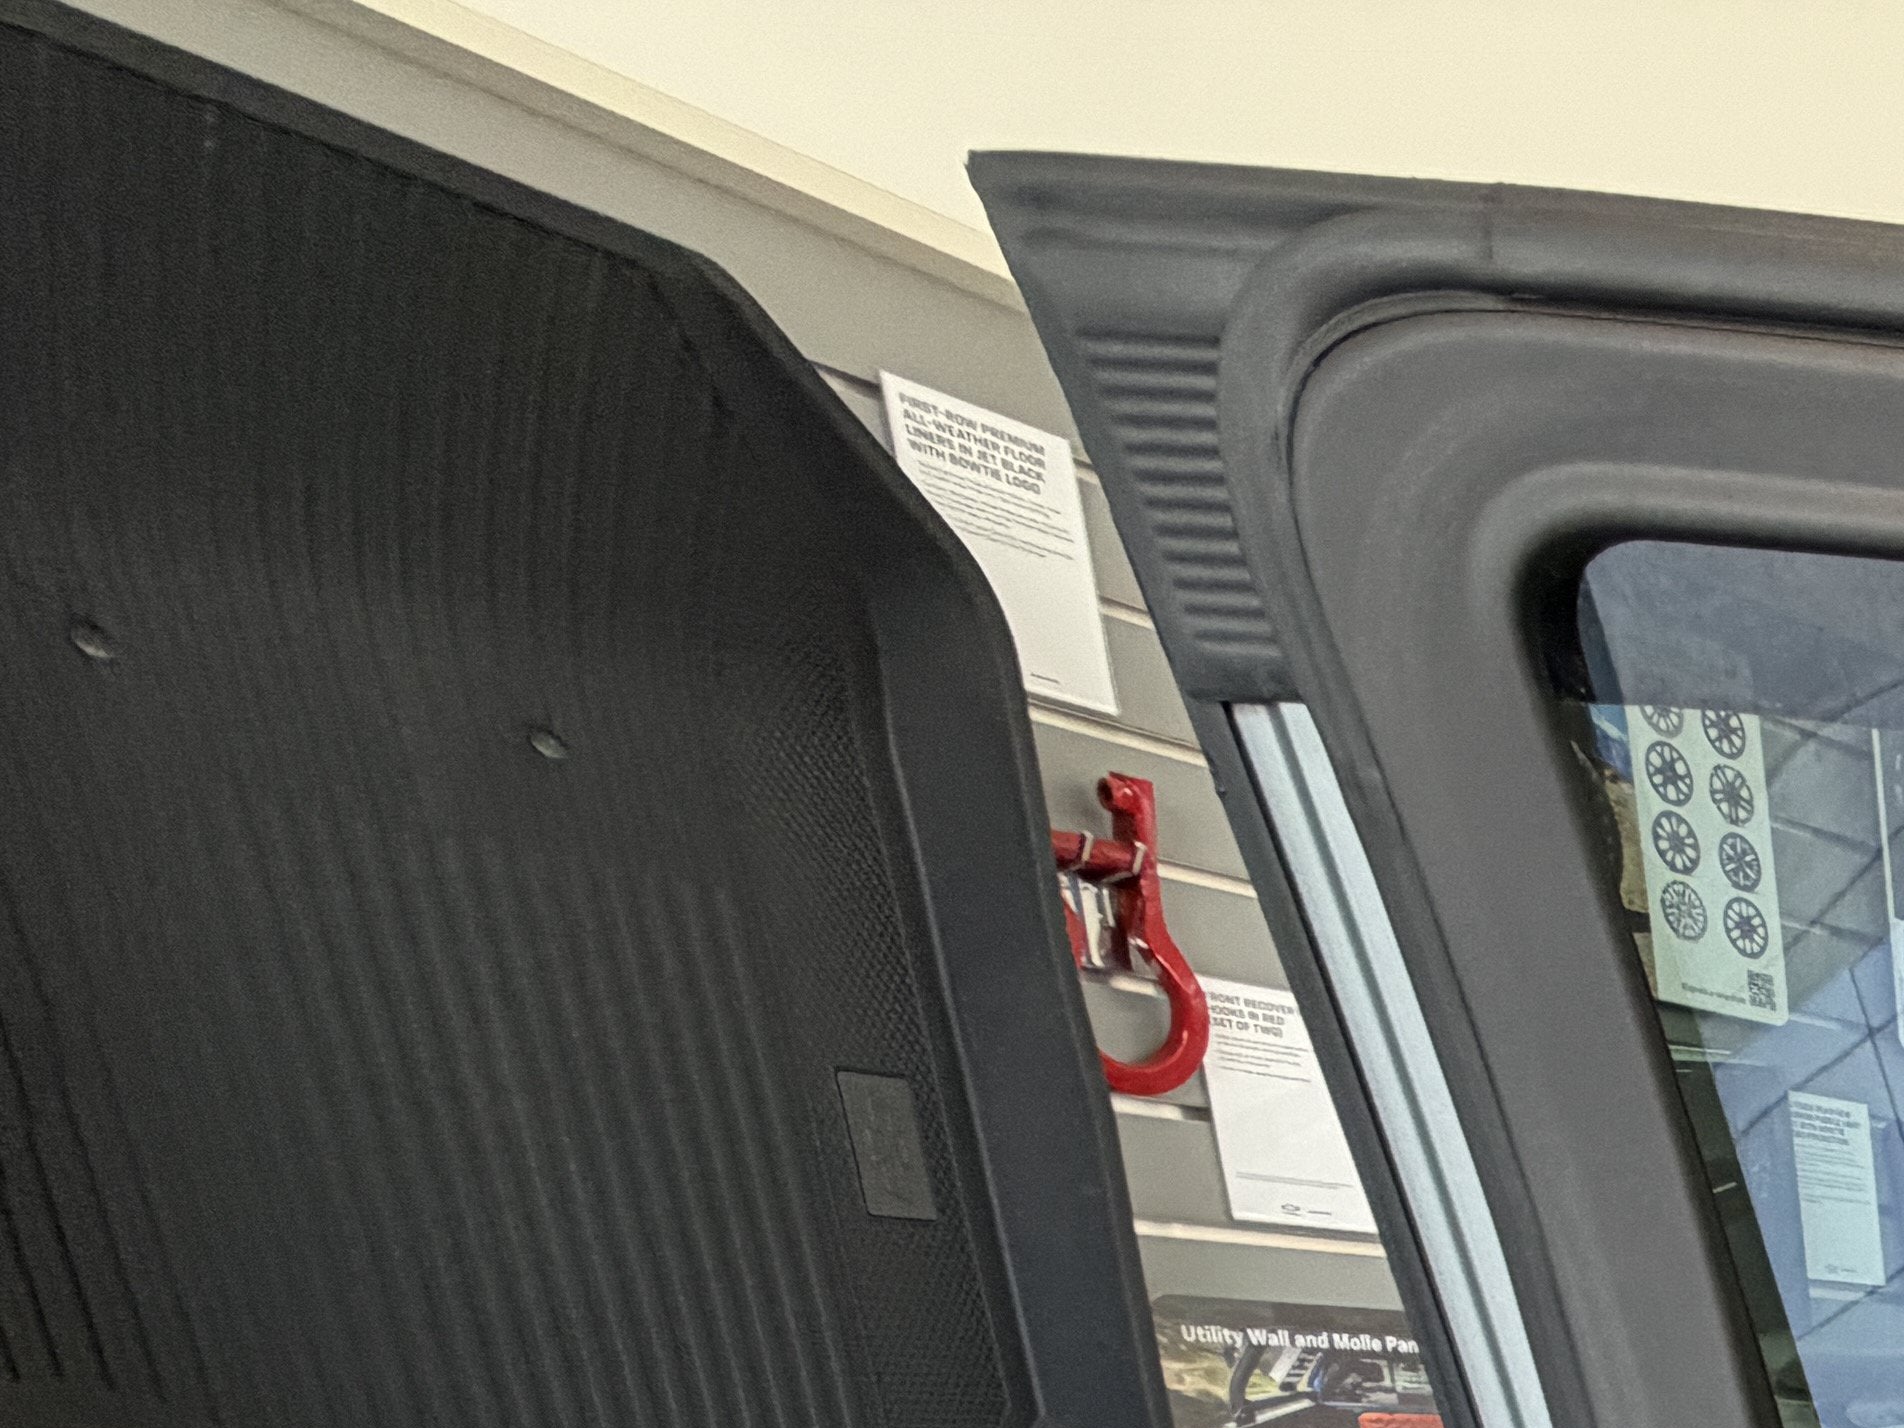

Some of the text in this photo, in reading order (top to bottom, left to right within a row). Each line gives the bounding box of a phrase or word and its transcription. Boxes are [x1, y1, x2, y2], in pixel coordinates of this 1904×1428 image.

[904, 408, 1046, 470] ALL-WEATHER FLOOR
[905, 424, 1046, 483] LINERS IN JET BLACK
[907, 438, 946, 461] WITH
[1005, 473, 1041, 495] LOGO
[1207, 992, 1295, 1015] RONT RECOVER
[1210, 1016, 1233, 1029] SET
[1180, 1324, 1244, 1348] Utility
[1246, 1327, 1291, 1348] Wall
[1294, 1330, 1329, 1349] and
[1384, 1334, 1420, 1354] Pan
